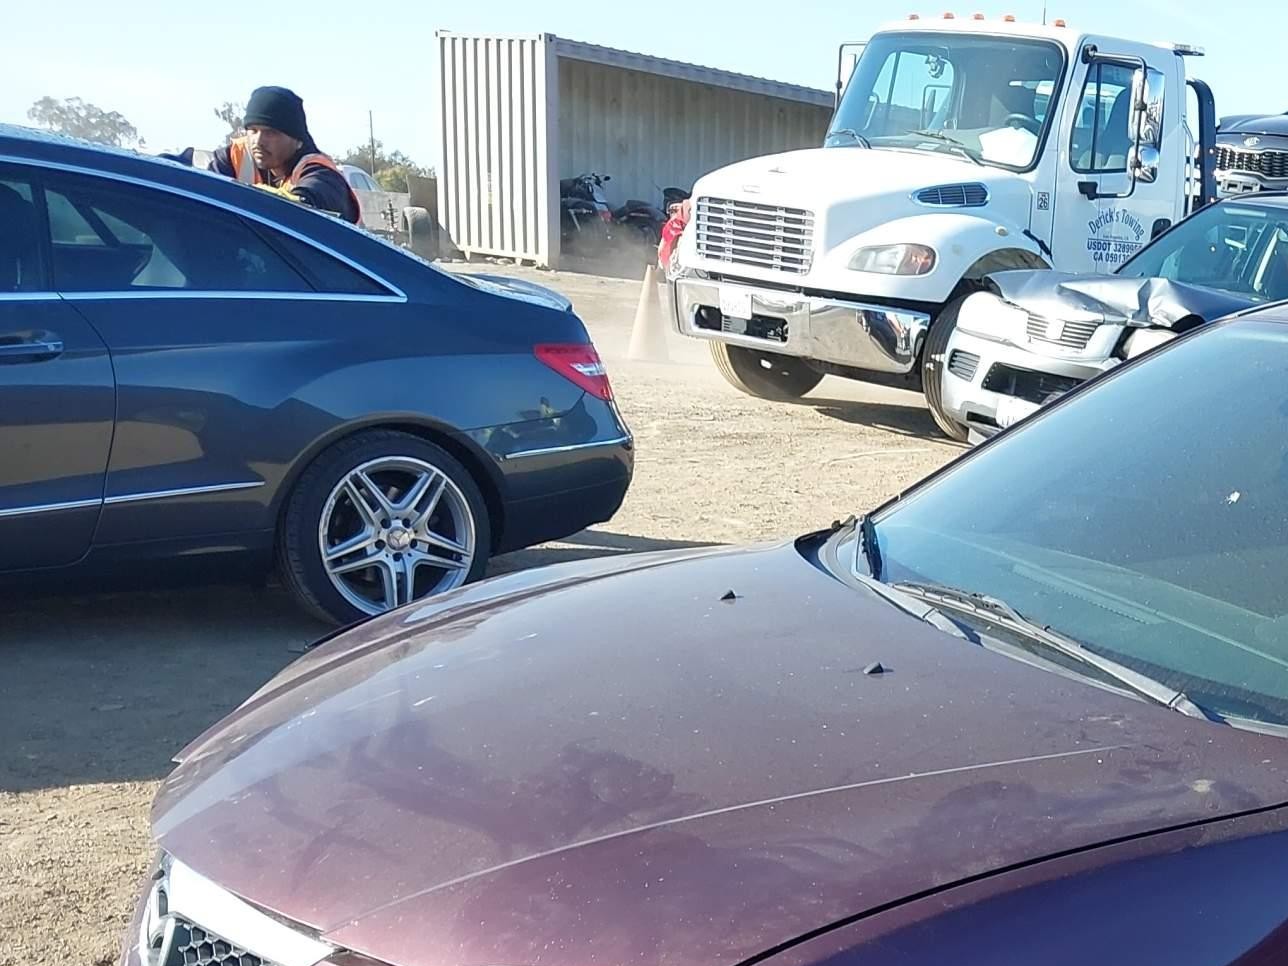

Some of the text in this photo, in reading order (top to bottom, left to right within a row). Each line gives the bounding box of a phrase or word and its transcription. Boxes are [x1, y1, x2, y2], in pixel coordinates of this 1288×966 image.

[1088, 208, 1144, 241] Derick's Towing
[1087, 241, 1142, 255] USDOT 32899
[1093, 251, 1104, 261] CA
